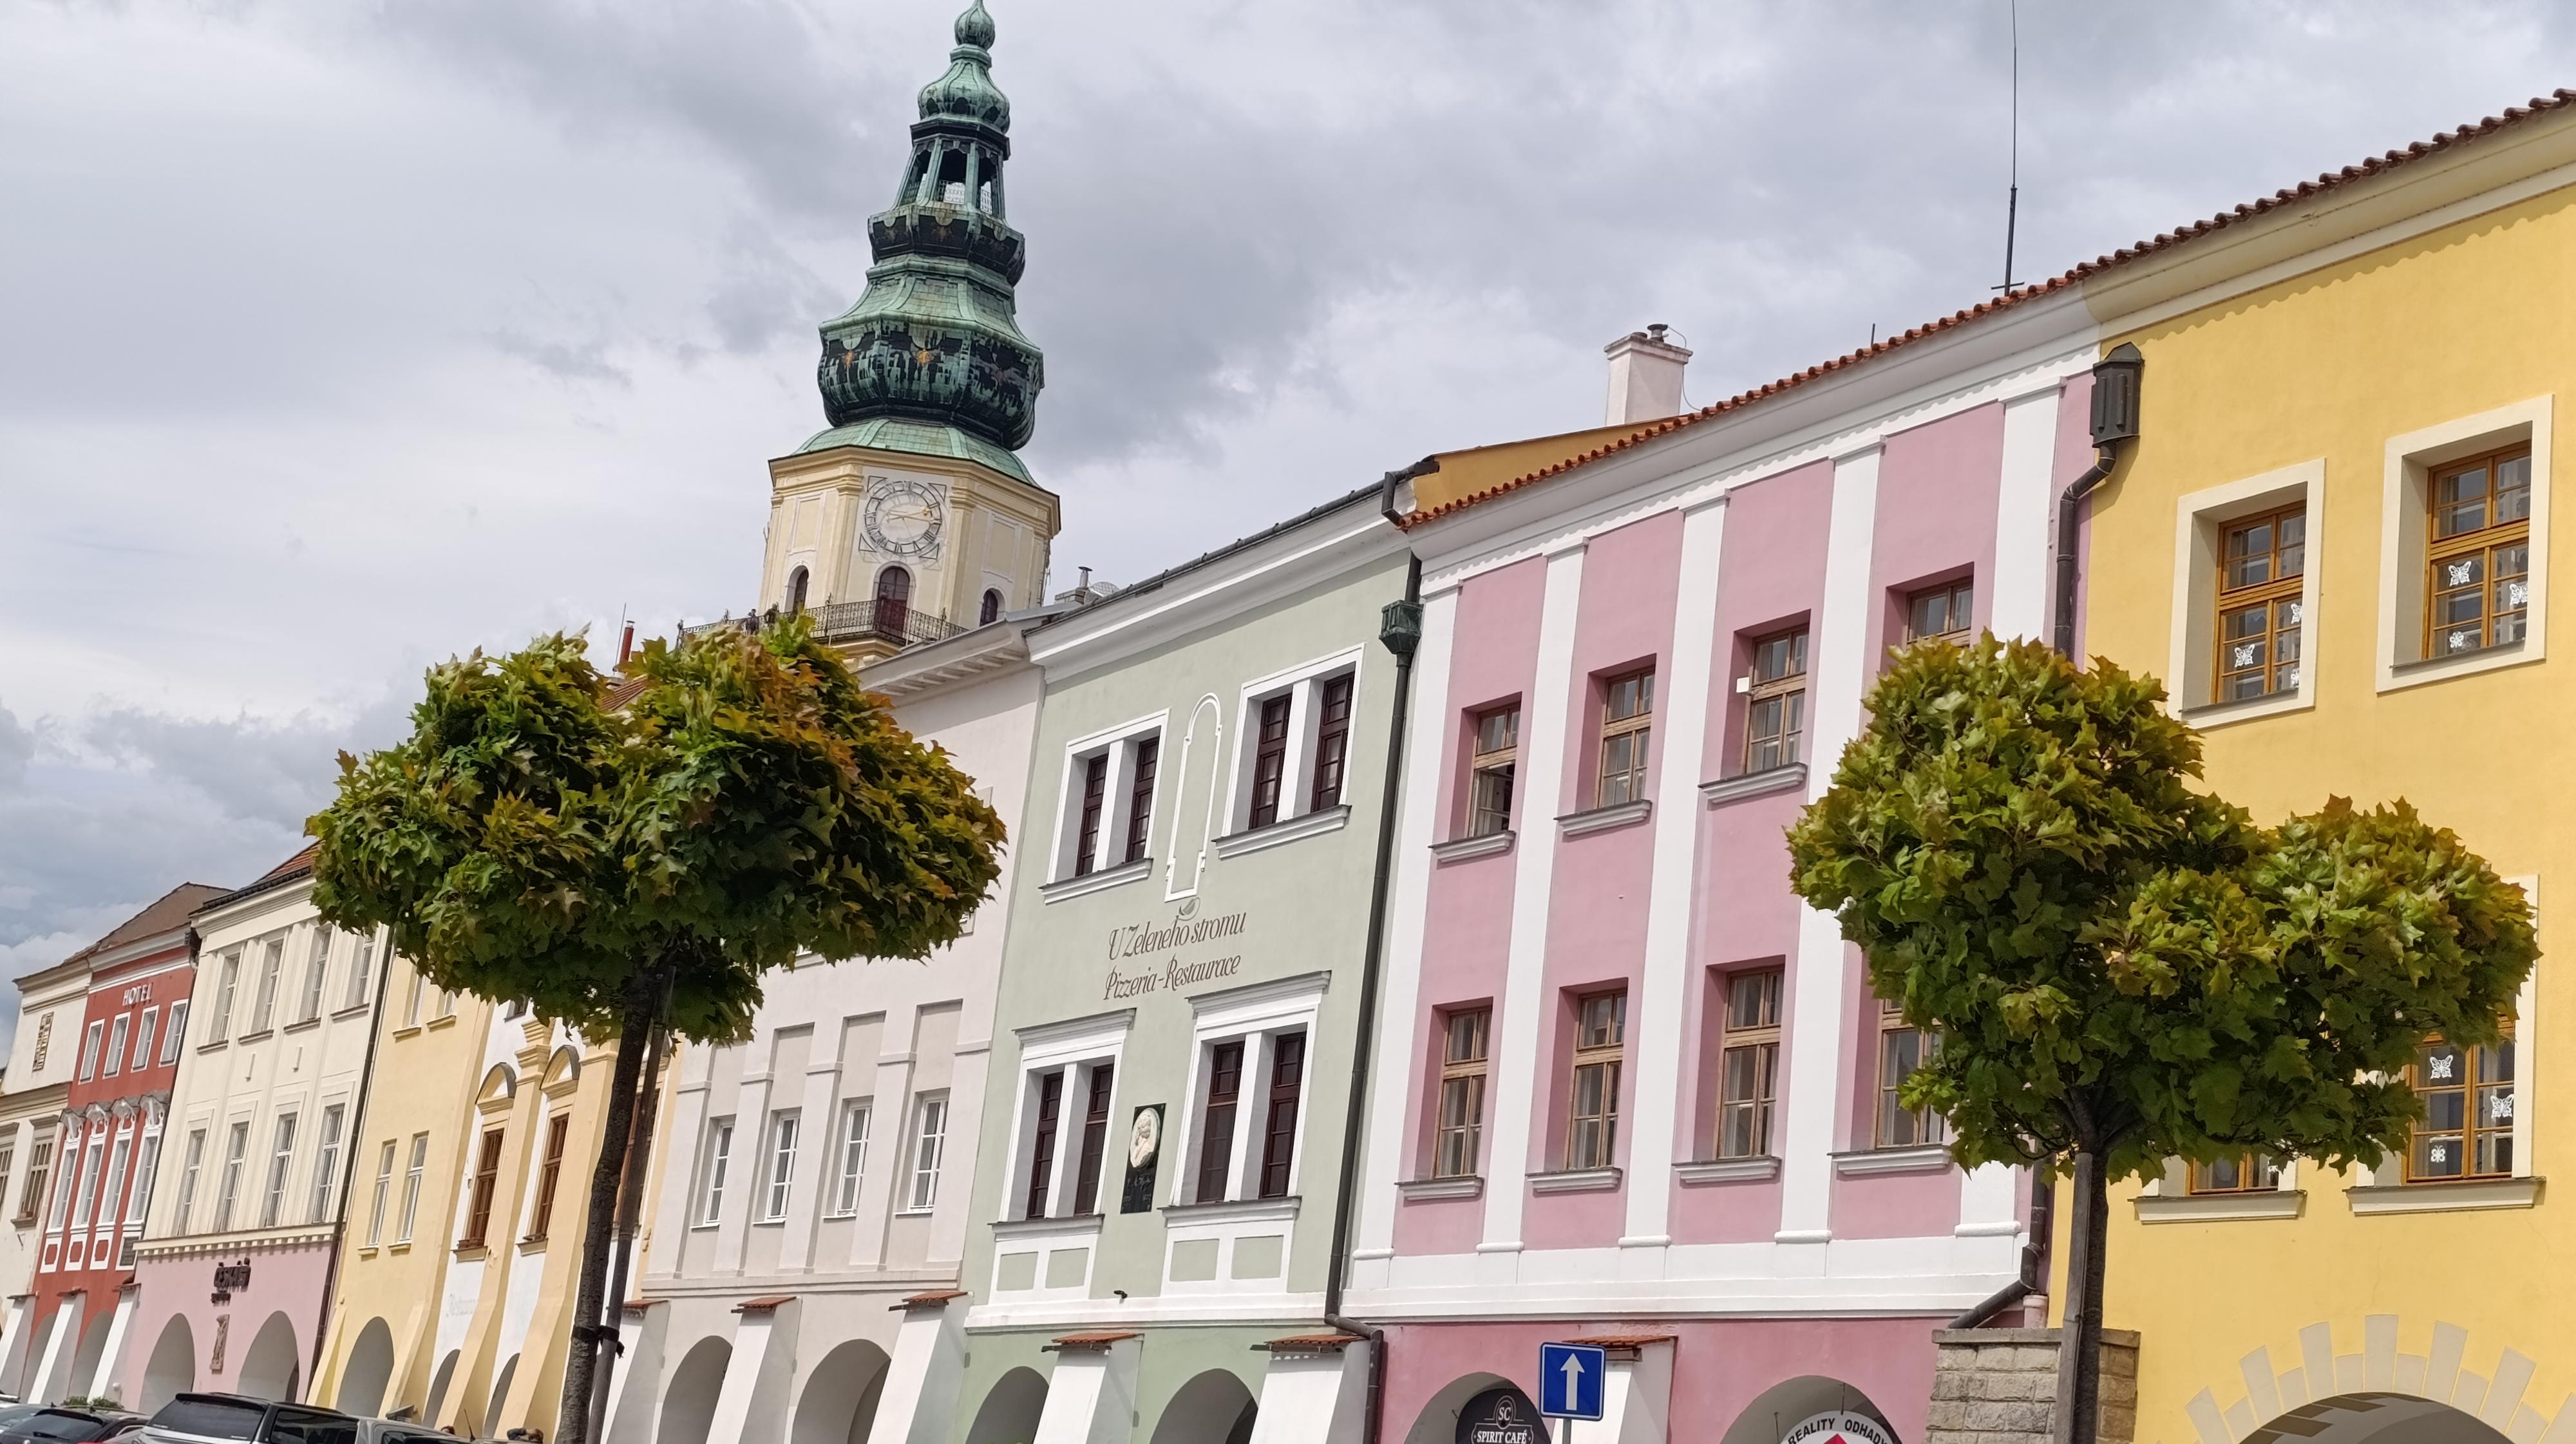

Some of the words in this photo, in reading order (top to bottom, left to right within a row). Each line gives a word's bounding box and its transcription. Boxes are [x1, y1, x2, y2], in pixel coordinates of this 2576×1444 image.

[1108, 927, 1127, 961] U
[1191, 912, 1247, 944] stromu
[122, 982, 153, 1006] HOTEL
[1498, 1407, 1511, 1421] SC
[1477, 1430, 1504, 1443] SPIRIT
[1504, 1429, 1528, 1444] CAFÉ
[1787, 1417, 1835, 1444] REALITY
